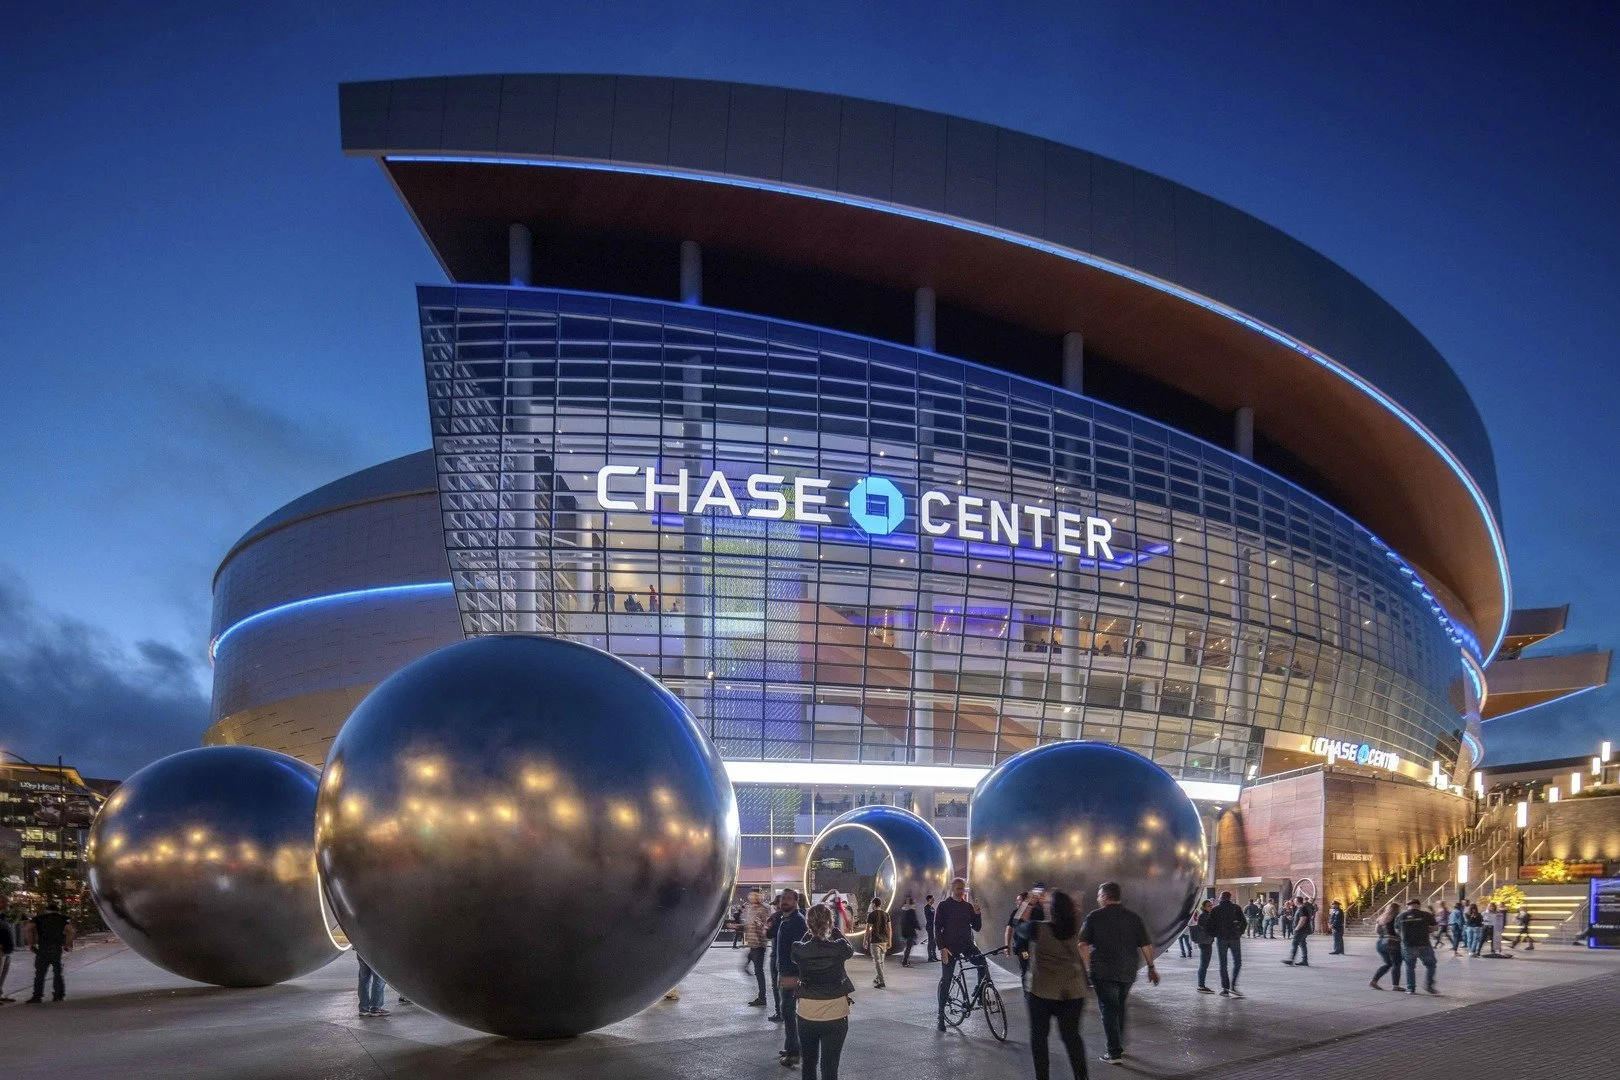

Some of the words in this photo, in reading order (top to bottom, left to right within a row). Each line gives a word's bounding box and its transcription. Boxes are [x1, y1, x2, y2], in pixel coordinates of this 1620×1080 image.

[597, 465, 832, 523] CHASE
[920, 489, 1114, 560] CENTER
[1314, 737, 1358, 762] CHASE
